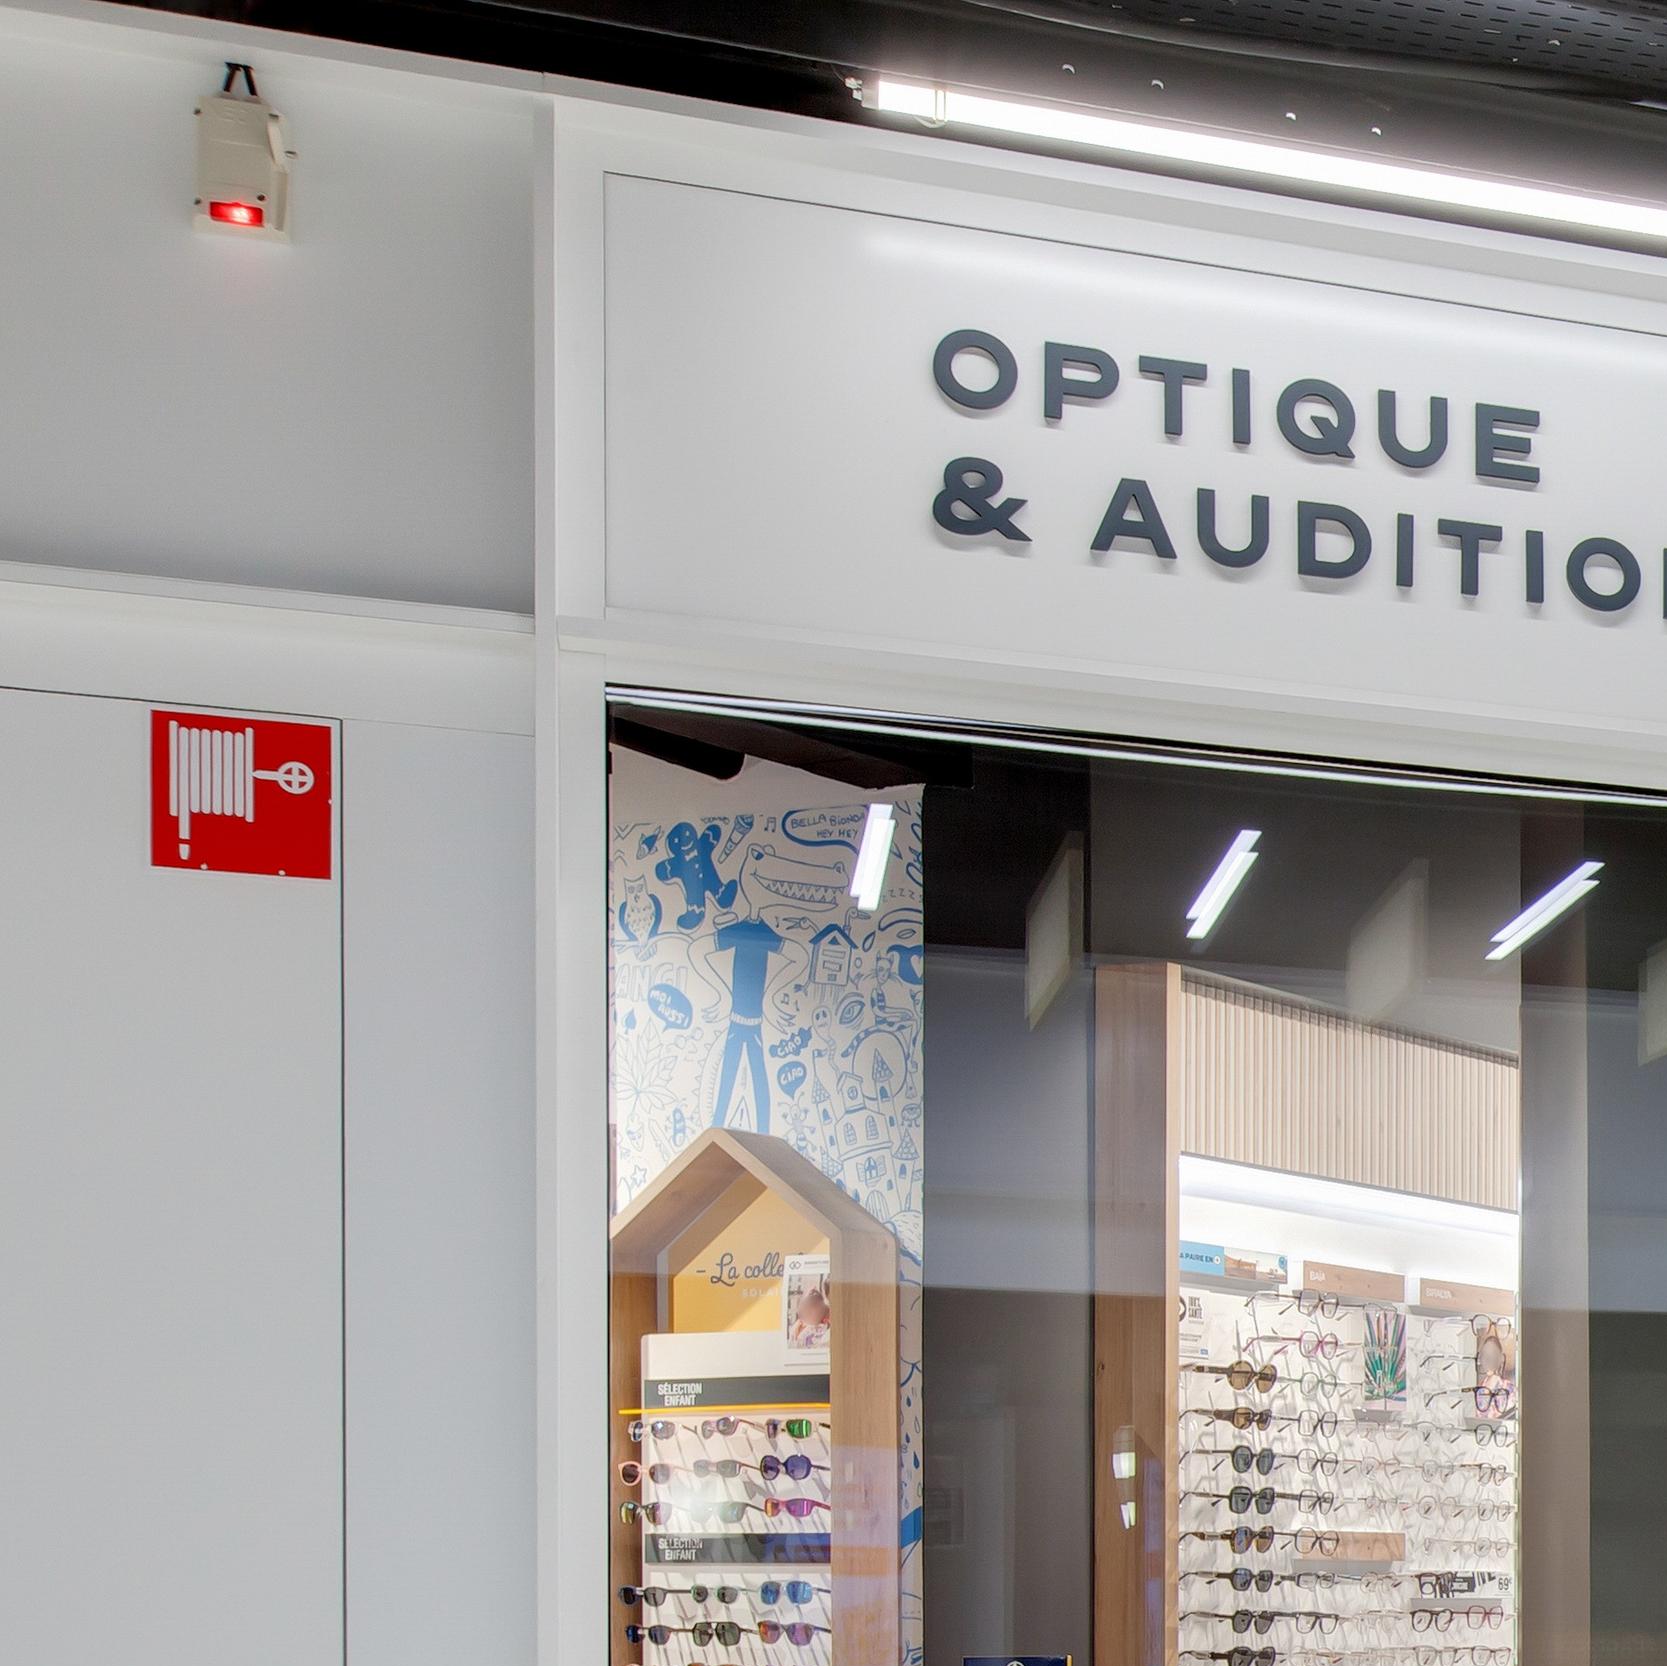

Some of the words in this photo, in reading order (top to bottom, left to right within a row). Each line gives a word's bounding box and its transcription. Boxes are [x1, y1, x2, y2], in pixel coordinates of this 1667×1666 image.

[932, 329, 1541, 484] OPTIQUE
[932, 457, 1032, 543] &
[744, 1252, 785, 1279] colle
[657, 1381, 702, 1396] SÉLECTION
[664, 1394, 696, 1407] ENFANT
